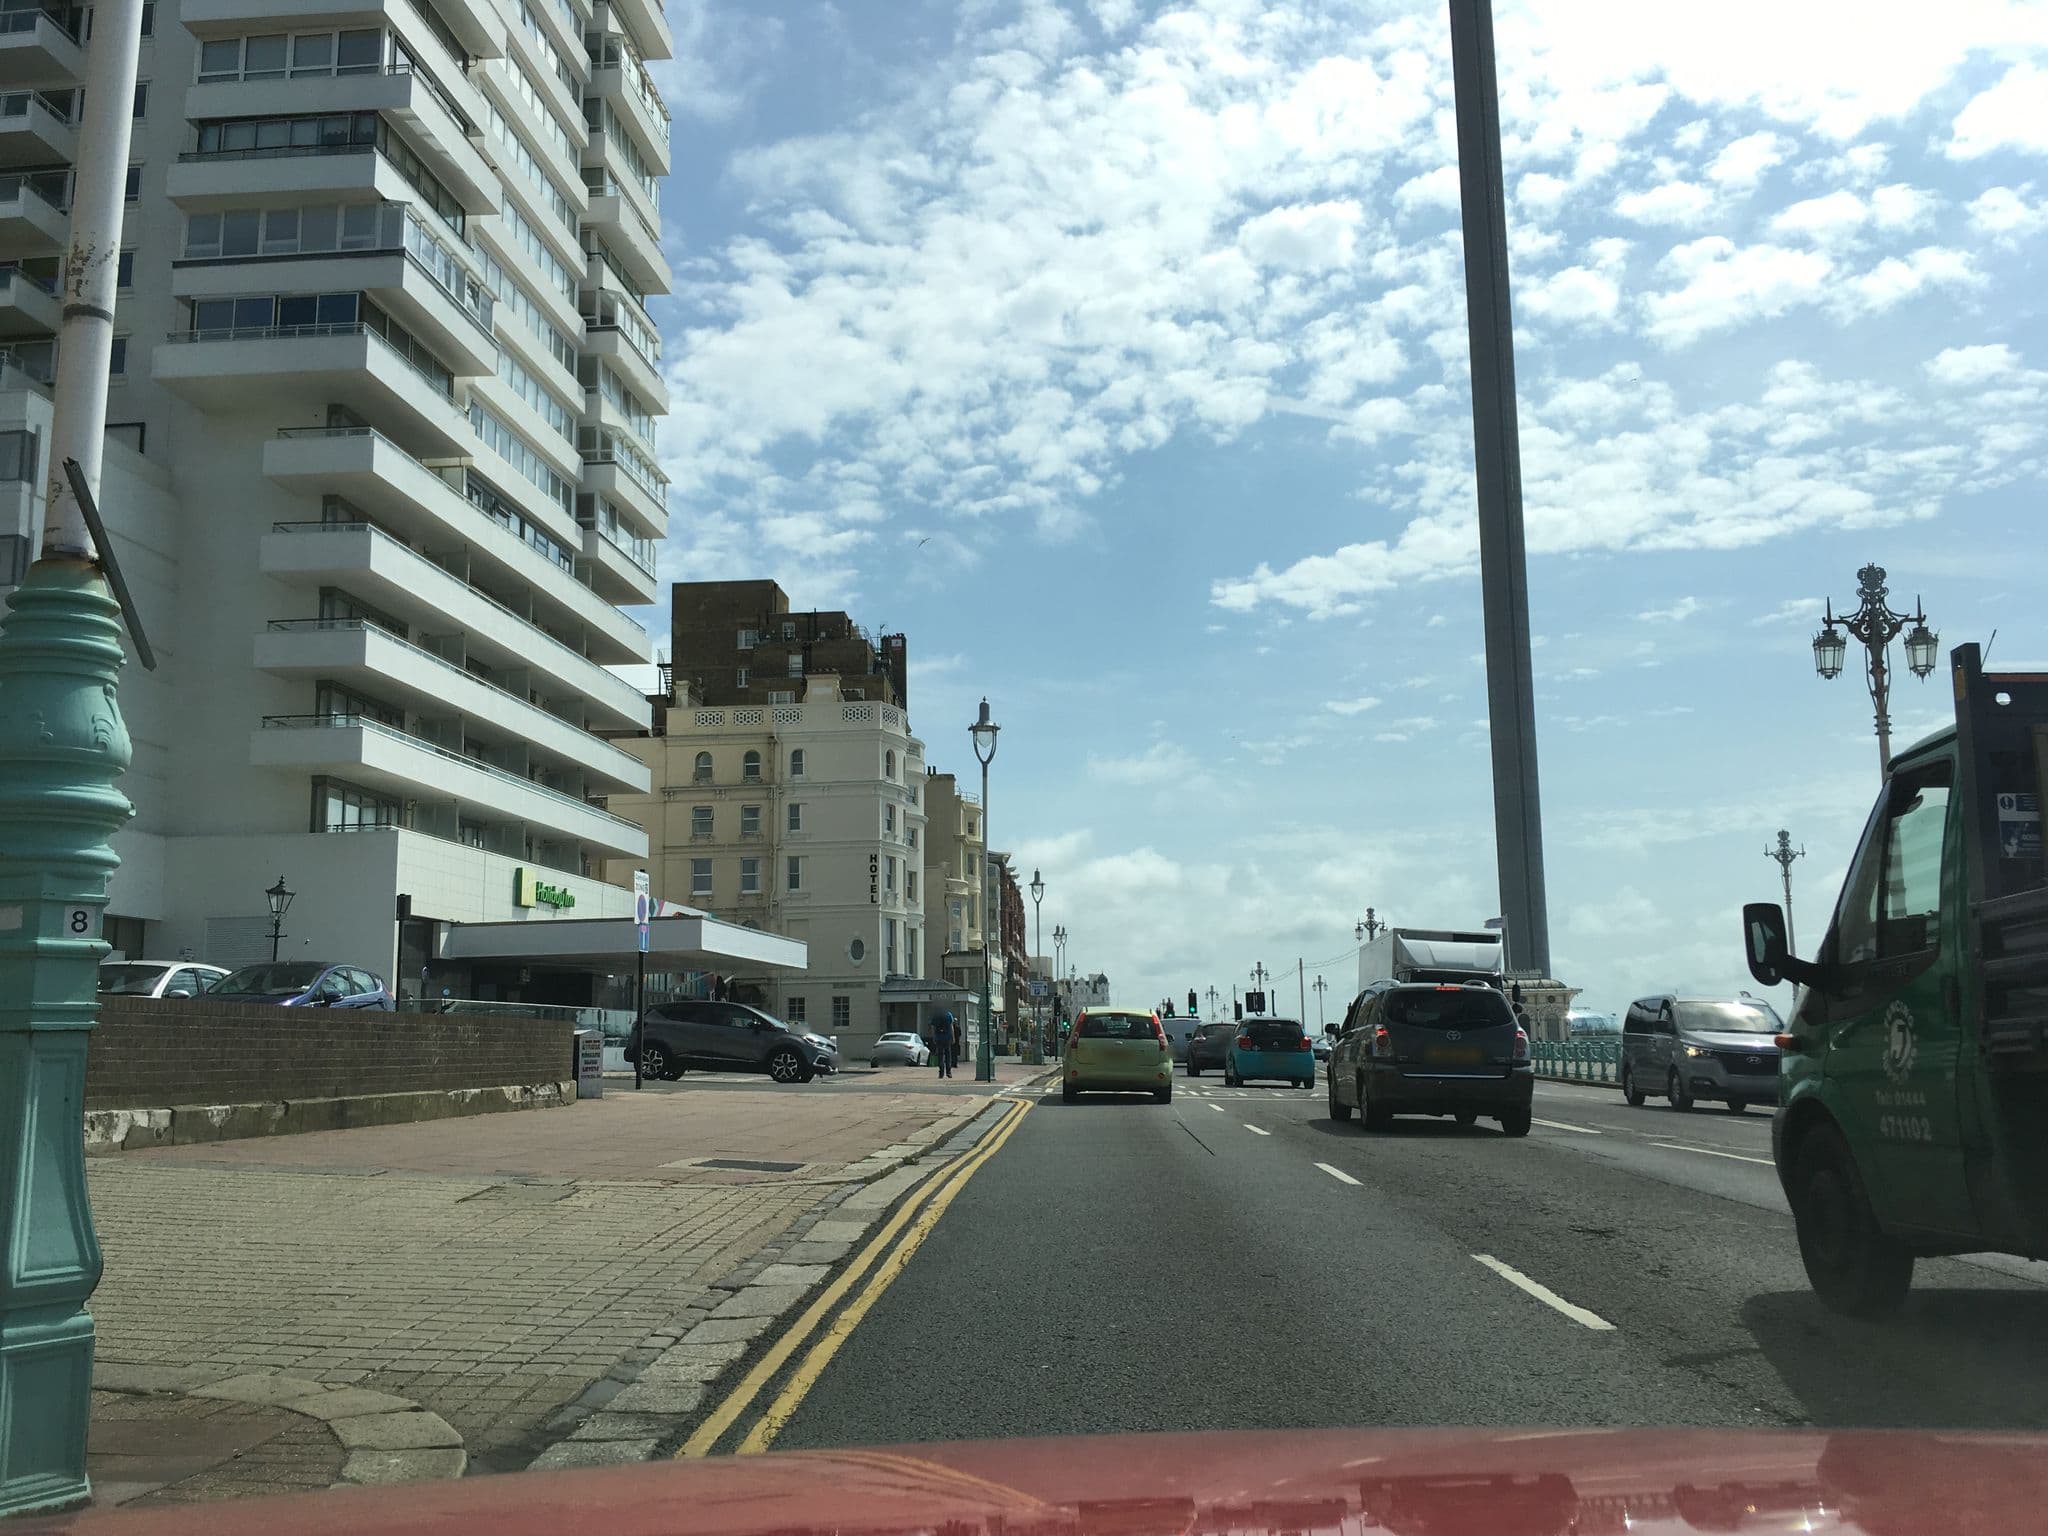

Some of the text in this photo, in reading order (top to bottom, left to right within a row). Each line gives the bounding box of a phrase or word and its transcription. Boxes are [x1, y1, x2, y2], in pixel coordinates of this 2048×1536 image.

[869, 854, 878, 904] HOTEL
[536, 881, 576, 909] Holiday Inn
[71, 911, 88, 933] 8
[1880, 1115, 1933, 1141] 471102
